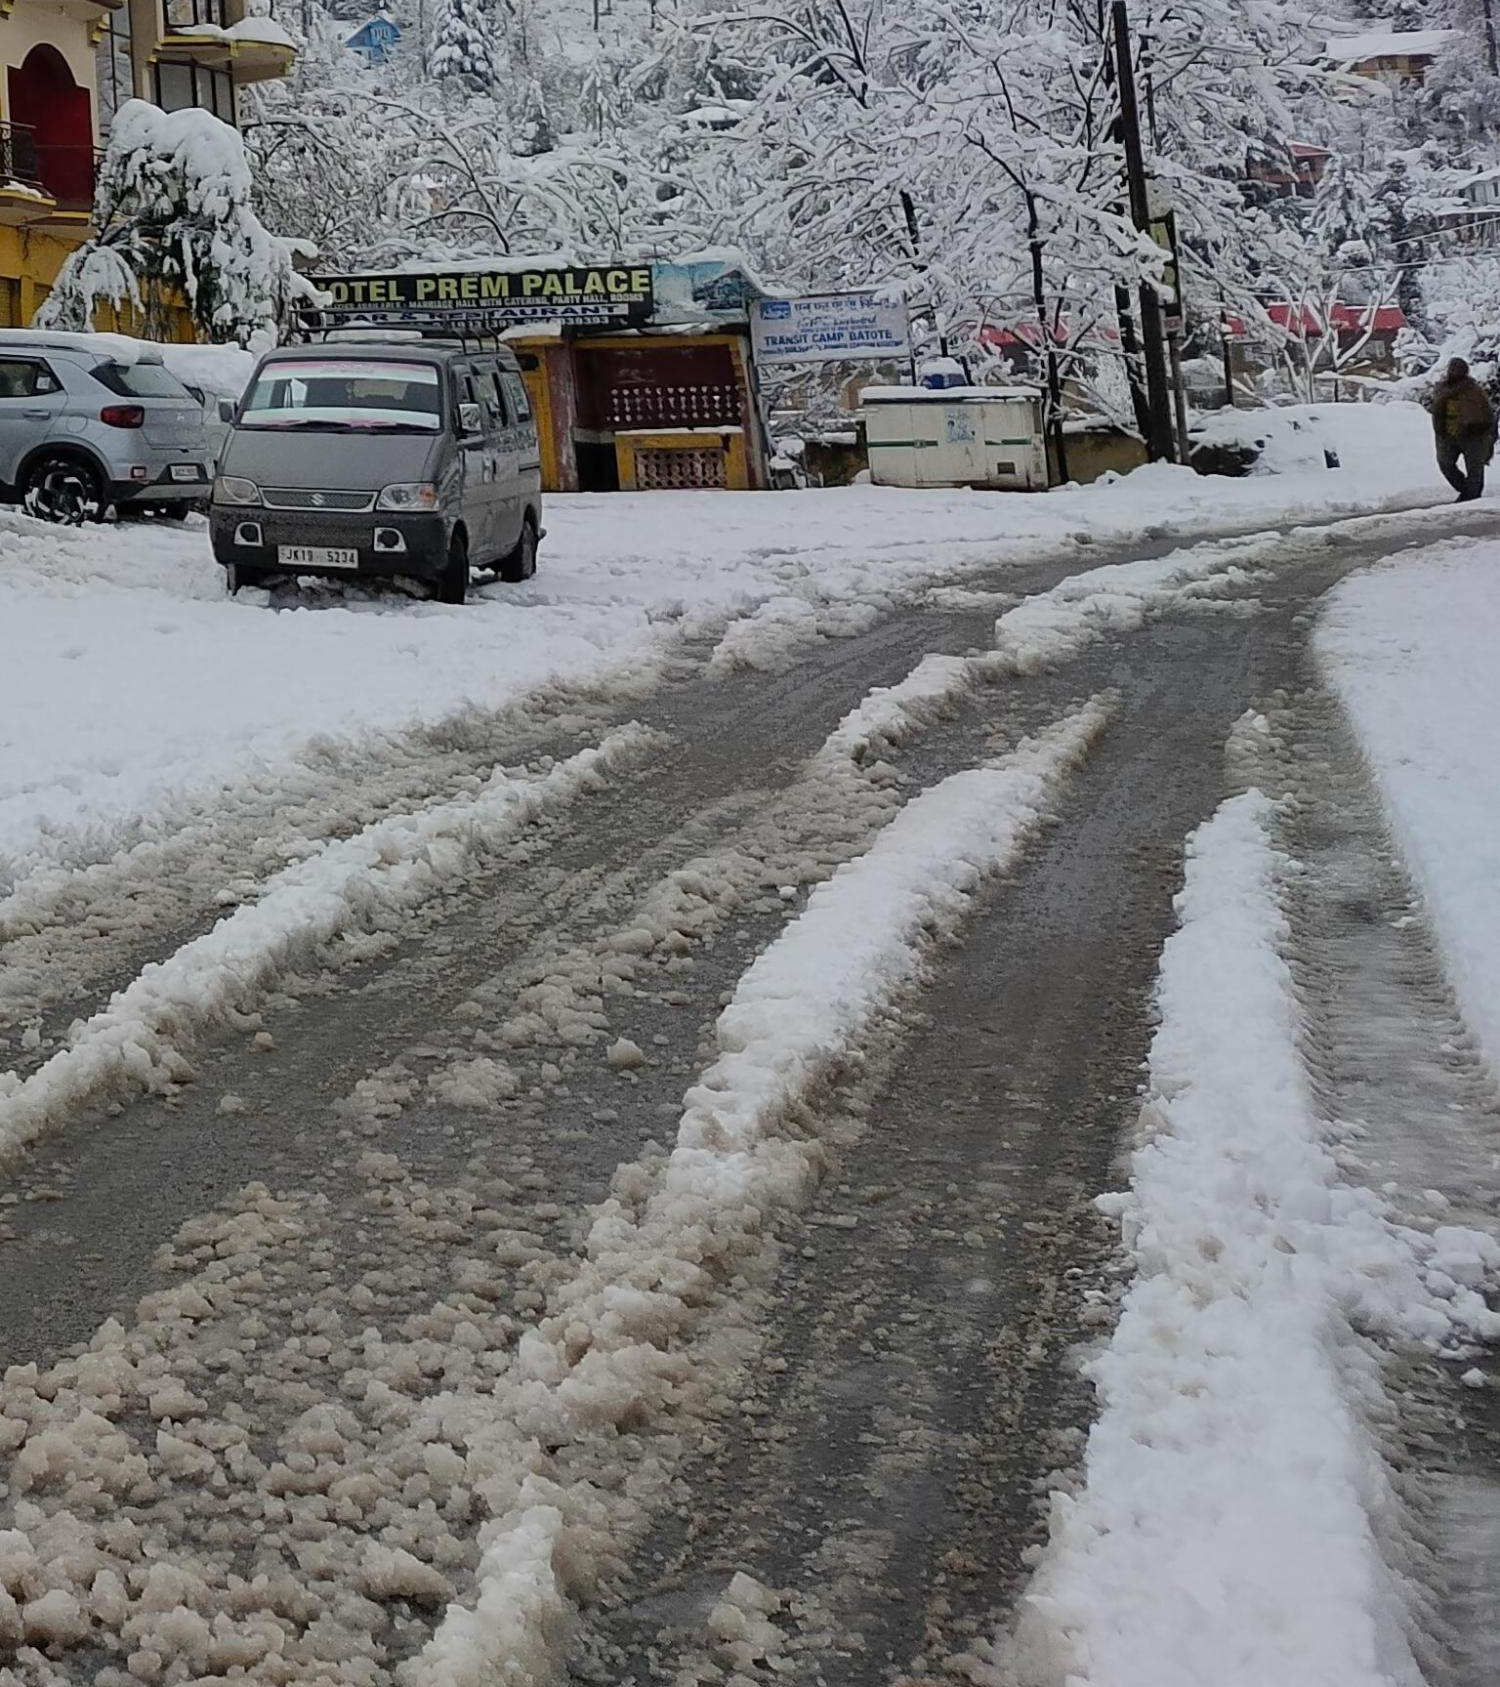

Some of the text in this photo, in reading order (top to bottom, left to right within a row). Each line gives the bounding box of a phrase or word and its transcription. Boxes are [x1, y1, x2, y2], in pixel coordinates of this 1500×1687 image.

[320, 269, 650, 304] OTEL PREM PALACE
[480, 297, 502, 307] WITH
[552, 294, 580, 305] PARTY
[610, 292, 644, 302] ROOMS
[764, 334, 808, 347] TRANSIT
[812, 332, 845, 344] CAMP
[850, 329, 893, 341] BATOTE
[286, 548, 355, 564] JK19 5234
